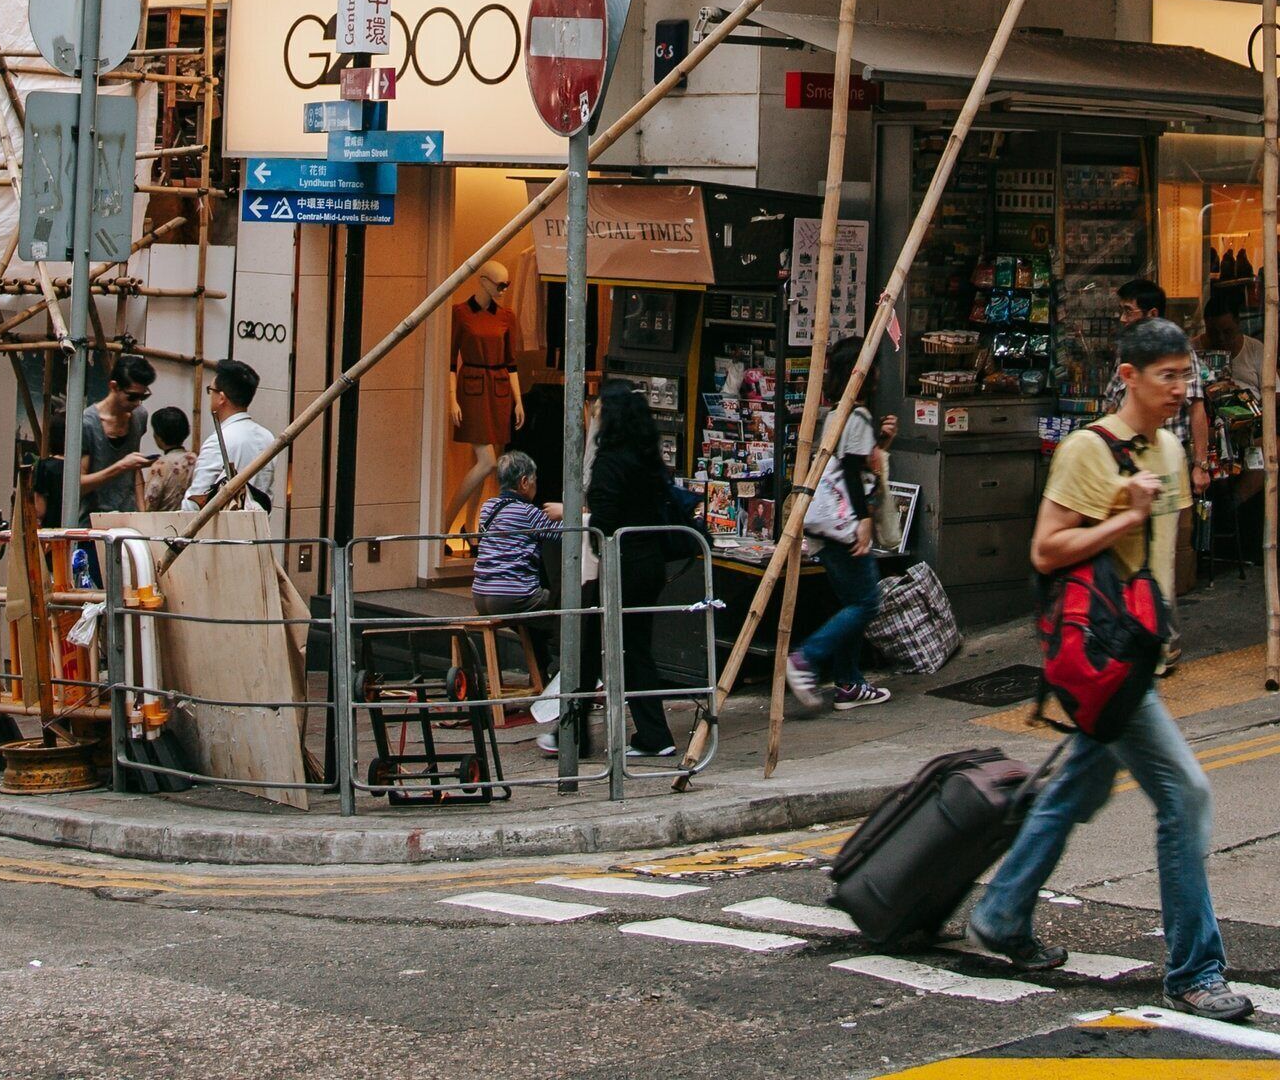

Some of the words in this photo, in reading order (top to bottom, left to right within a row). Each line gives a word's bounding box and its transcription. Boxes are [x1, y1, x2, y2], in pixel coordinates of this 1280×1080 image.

[806, 82, 865, 102] Smane
[344, 149, 370, 160] Wyndham
[371, 149, 389, 158] Street
[299, 178, 337, 189] Lyndhurst
[338, 179, 365, 189] Terrace
[297, 212, 359, 223] Central-Mid-Levels
[360, 214, 392, 224] Escalator
[545, 219, 637, 241] FINCIAL
[637, 221, 694, 243] TIMES
[236, 320, 288, 343] G2000
